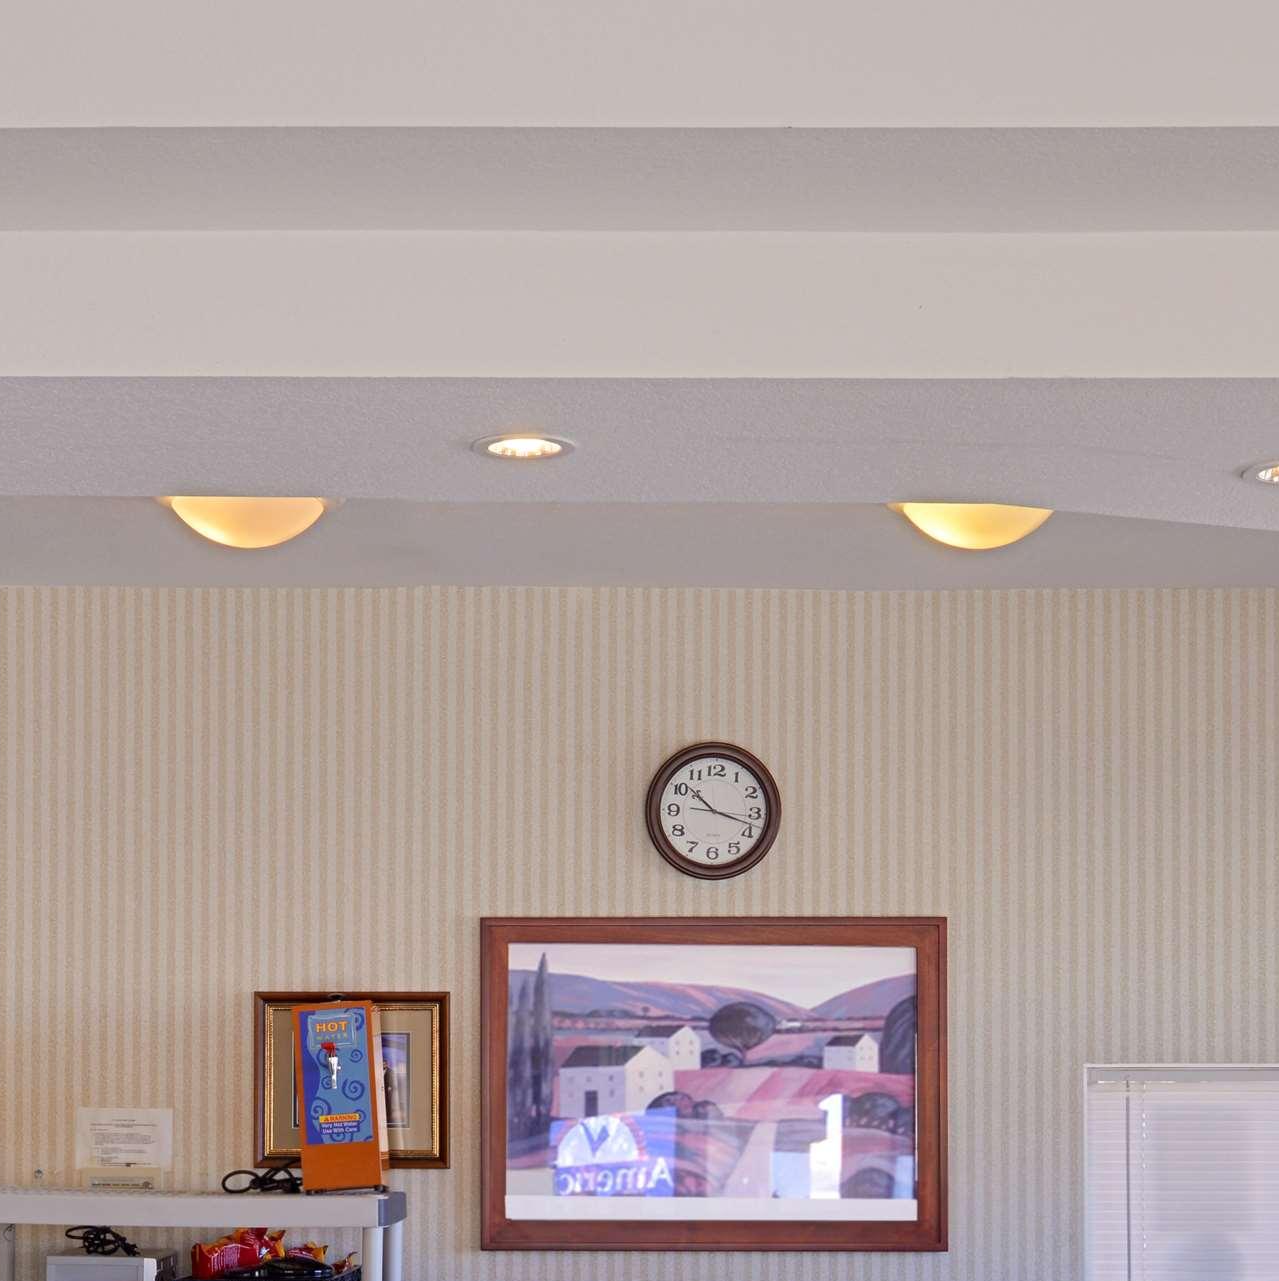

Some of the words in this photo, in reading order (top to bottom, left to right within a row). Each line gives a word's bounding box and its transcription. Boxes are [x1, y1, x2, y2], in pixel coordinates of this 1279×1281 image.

[689, 769, 702, 781] 11
[707, 764, 726, 778] 12
[734, 771, 739, 783] 1
[673, 782, 689, 796] 10
[744, 786, 758, 799] 2
[667, 803, 680, 817] 9
[748, 807, 761, 820] 3
[671, 824, 685, 837] 8
[741, 824, 753, 838] 4
[686, 840, 699, 853] 7
[728, 841, 740, 855] 5
[706, 847, 719, 860] 6
[316, 1020, 348, 1033] HOT
